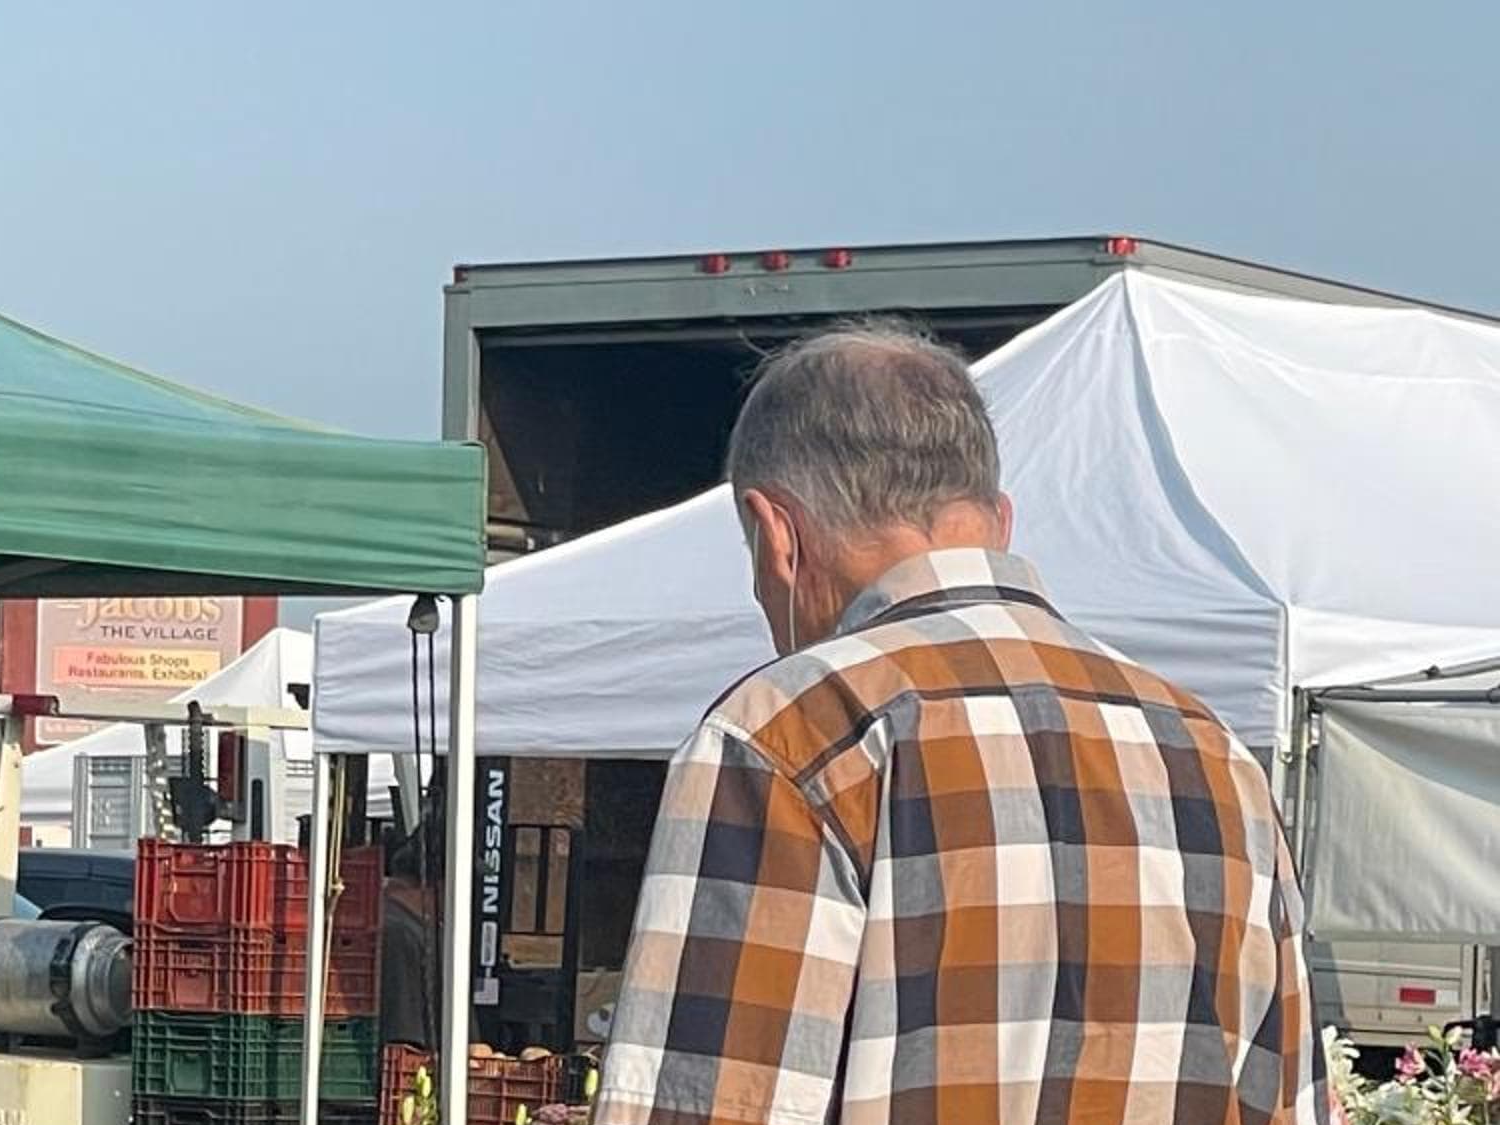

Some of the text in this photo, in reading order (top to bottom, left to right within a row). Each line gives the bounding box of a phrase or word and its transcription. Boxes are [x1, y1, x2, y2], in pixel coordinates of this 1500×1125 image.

[100, 625, 218, 641] THE VILLAGE
[86, 652, 190, 668] Fabulous Shops
[482, 769, 505, 914] NISSAN
